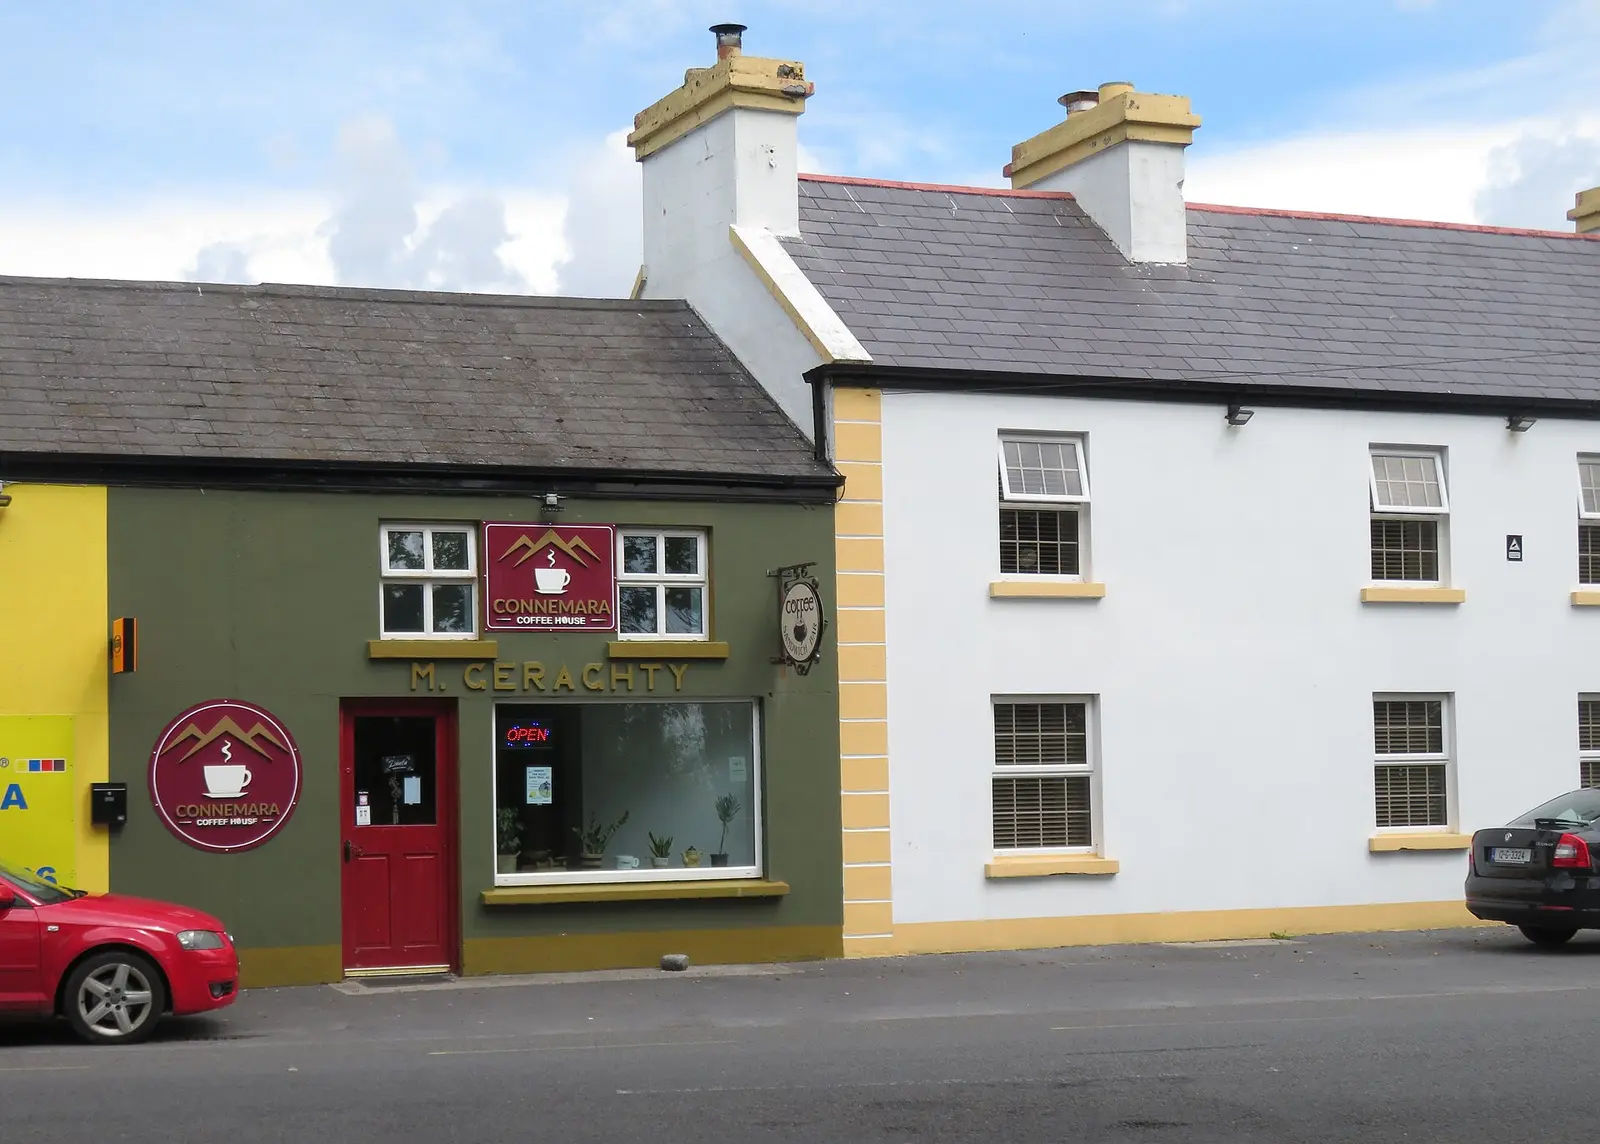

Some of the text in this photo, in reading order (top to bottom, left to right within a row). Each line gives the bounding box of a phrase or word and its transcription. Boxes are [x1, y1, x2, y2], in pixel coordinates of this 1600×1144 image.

[493, 598, 611, 615] CONNEMARA
[785, 596, 815, 619] coffee
[516, 615, 586, 626] COFFEE HOUSE
[411, 661, 690, 691] M. GERAGHTY
[507, 728, 548, 741] OPEN
[175, 803, 280, 818] CONNEMARA
[196, 816, 258, 826] COFFEE HOUSE
